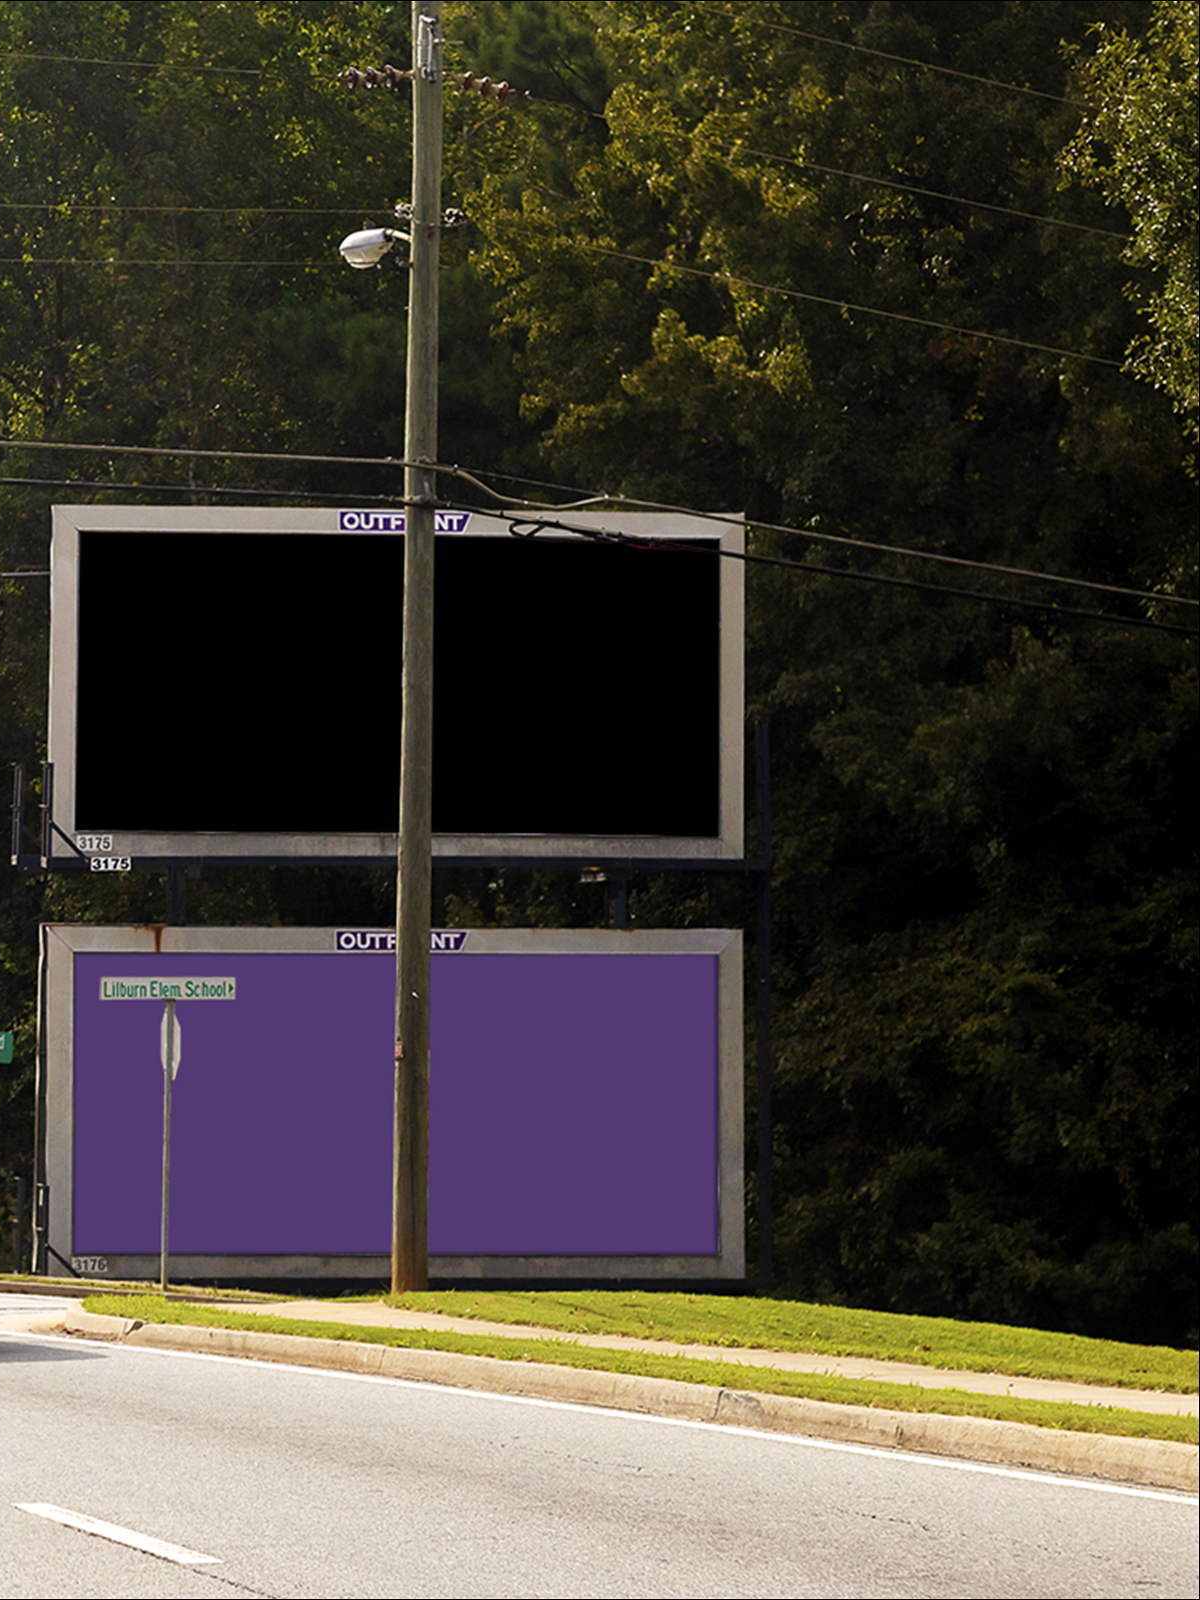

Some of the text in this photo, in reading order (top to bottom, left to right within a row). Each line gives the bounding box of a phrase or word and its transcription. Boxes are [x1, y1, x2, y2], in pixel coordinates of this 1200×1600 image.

[343, 513, 464, 530] OUTFNT
[79, 837, 111, 849] 3175
[92, 858, 129, 870] 3175
[340, 932, 460, 949] OUTFNT
[103, 981, 147, 998] Lilburn
[185, 980, 226, 998] School
